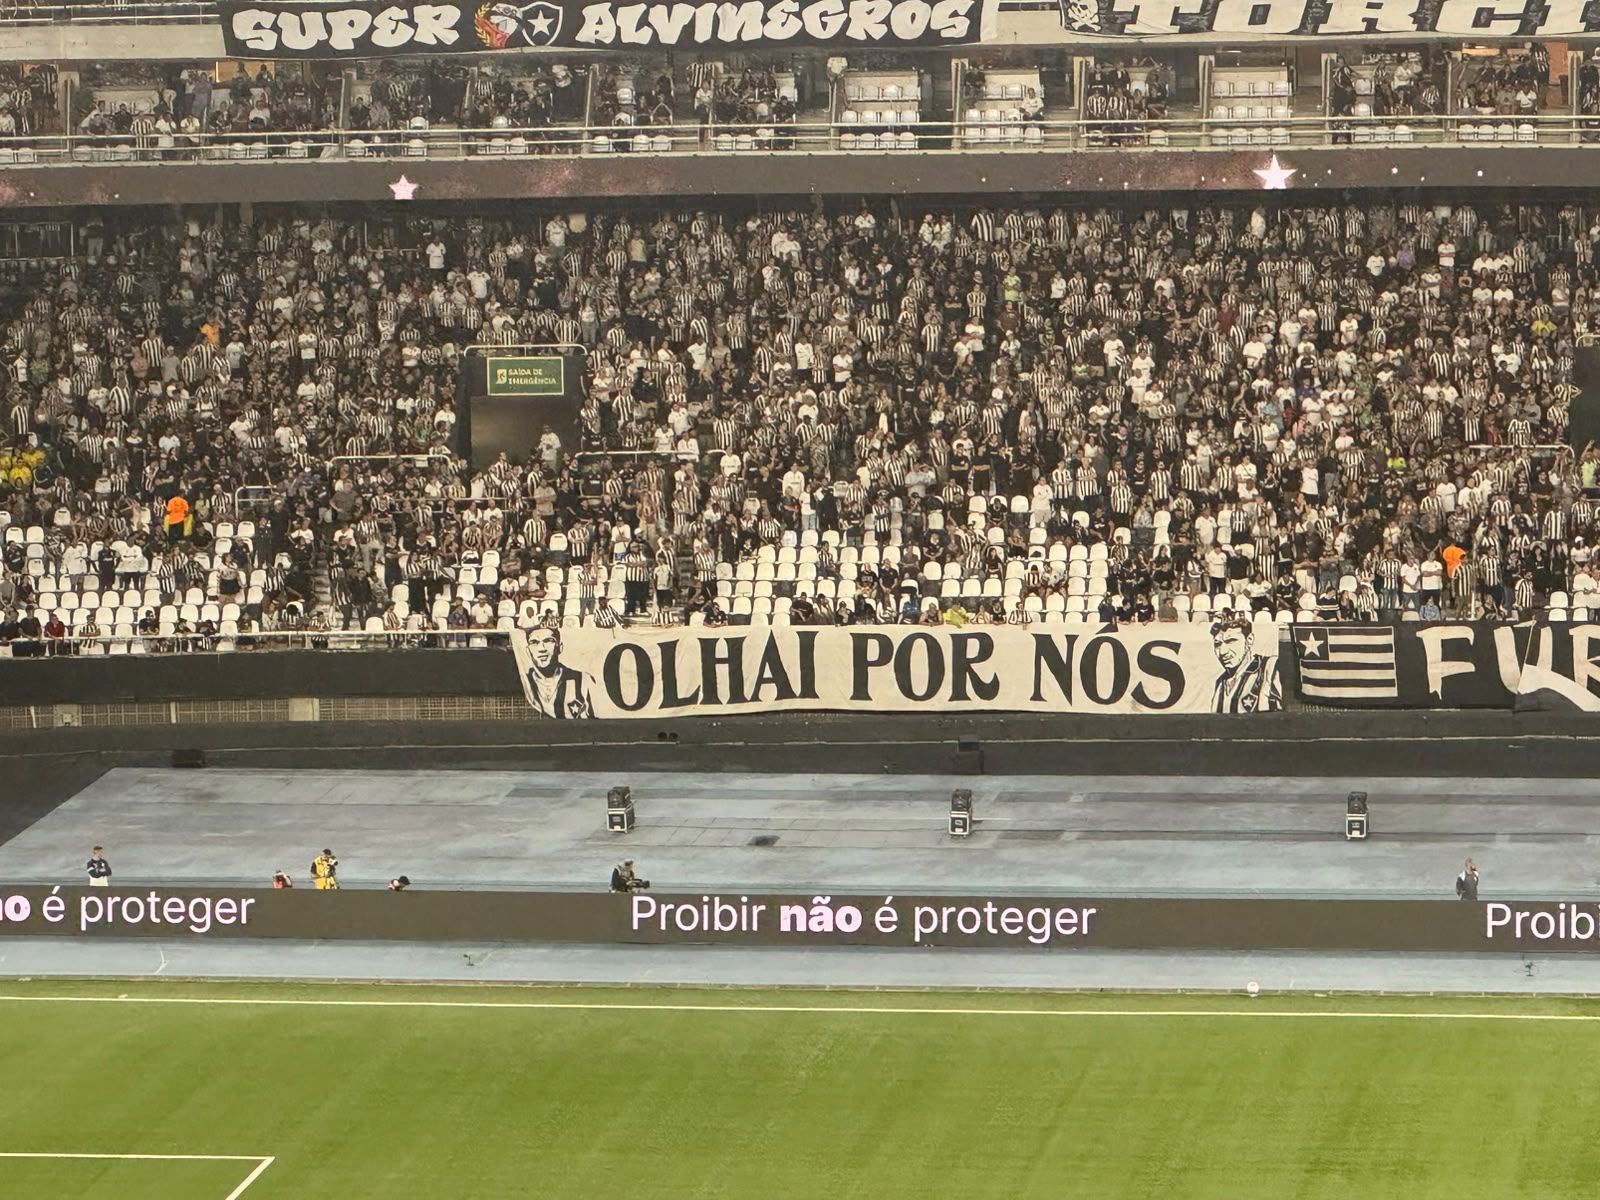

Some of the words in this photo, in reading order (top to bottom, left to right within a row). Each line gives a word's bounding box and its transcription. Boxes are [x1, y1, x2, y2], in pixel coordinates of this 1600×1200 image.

[232, 4, 461, 51] SUPER
[575, 0, 976, 45] ALVINEGROS
[508, 367, 531, 376] SAÍDA
[533, 368, 543, 376] DE
[508, 376, 557, 385] EMERGÊNCIA
[603, 629, 820, 712] OLHAI
[850, 631, 1000, 701] POR
[1029, 623, 1186, 709] NÓS
[42, 886, 65, 922] é
[81, 891, 255, 933] proteger
[632, 895, 766, 931] Proibir
[780, 896, 862, 933] não
[874, 895, 898, 933] é
[914, 901, 1097, 944] proteger
